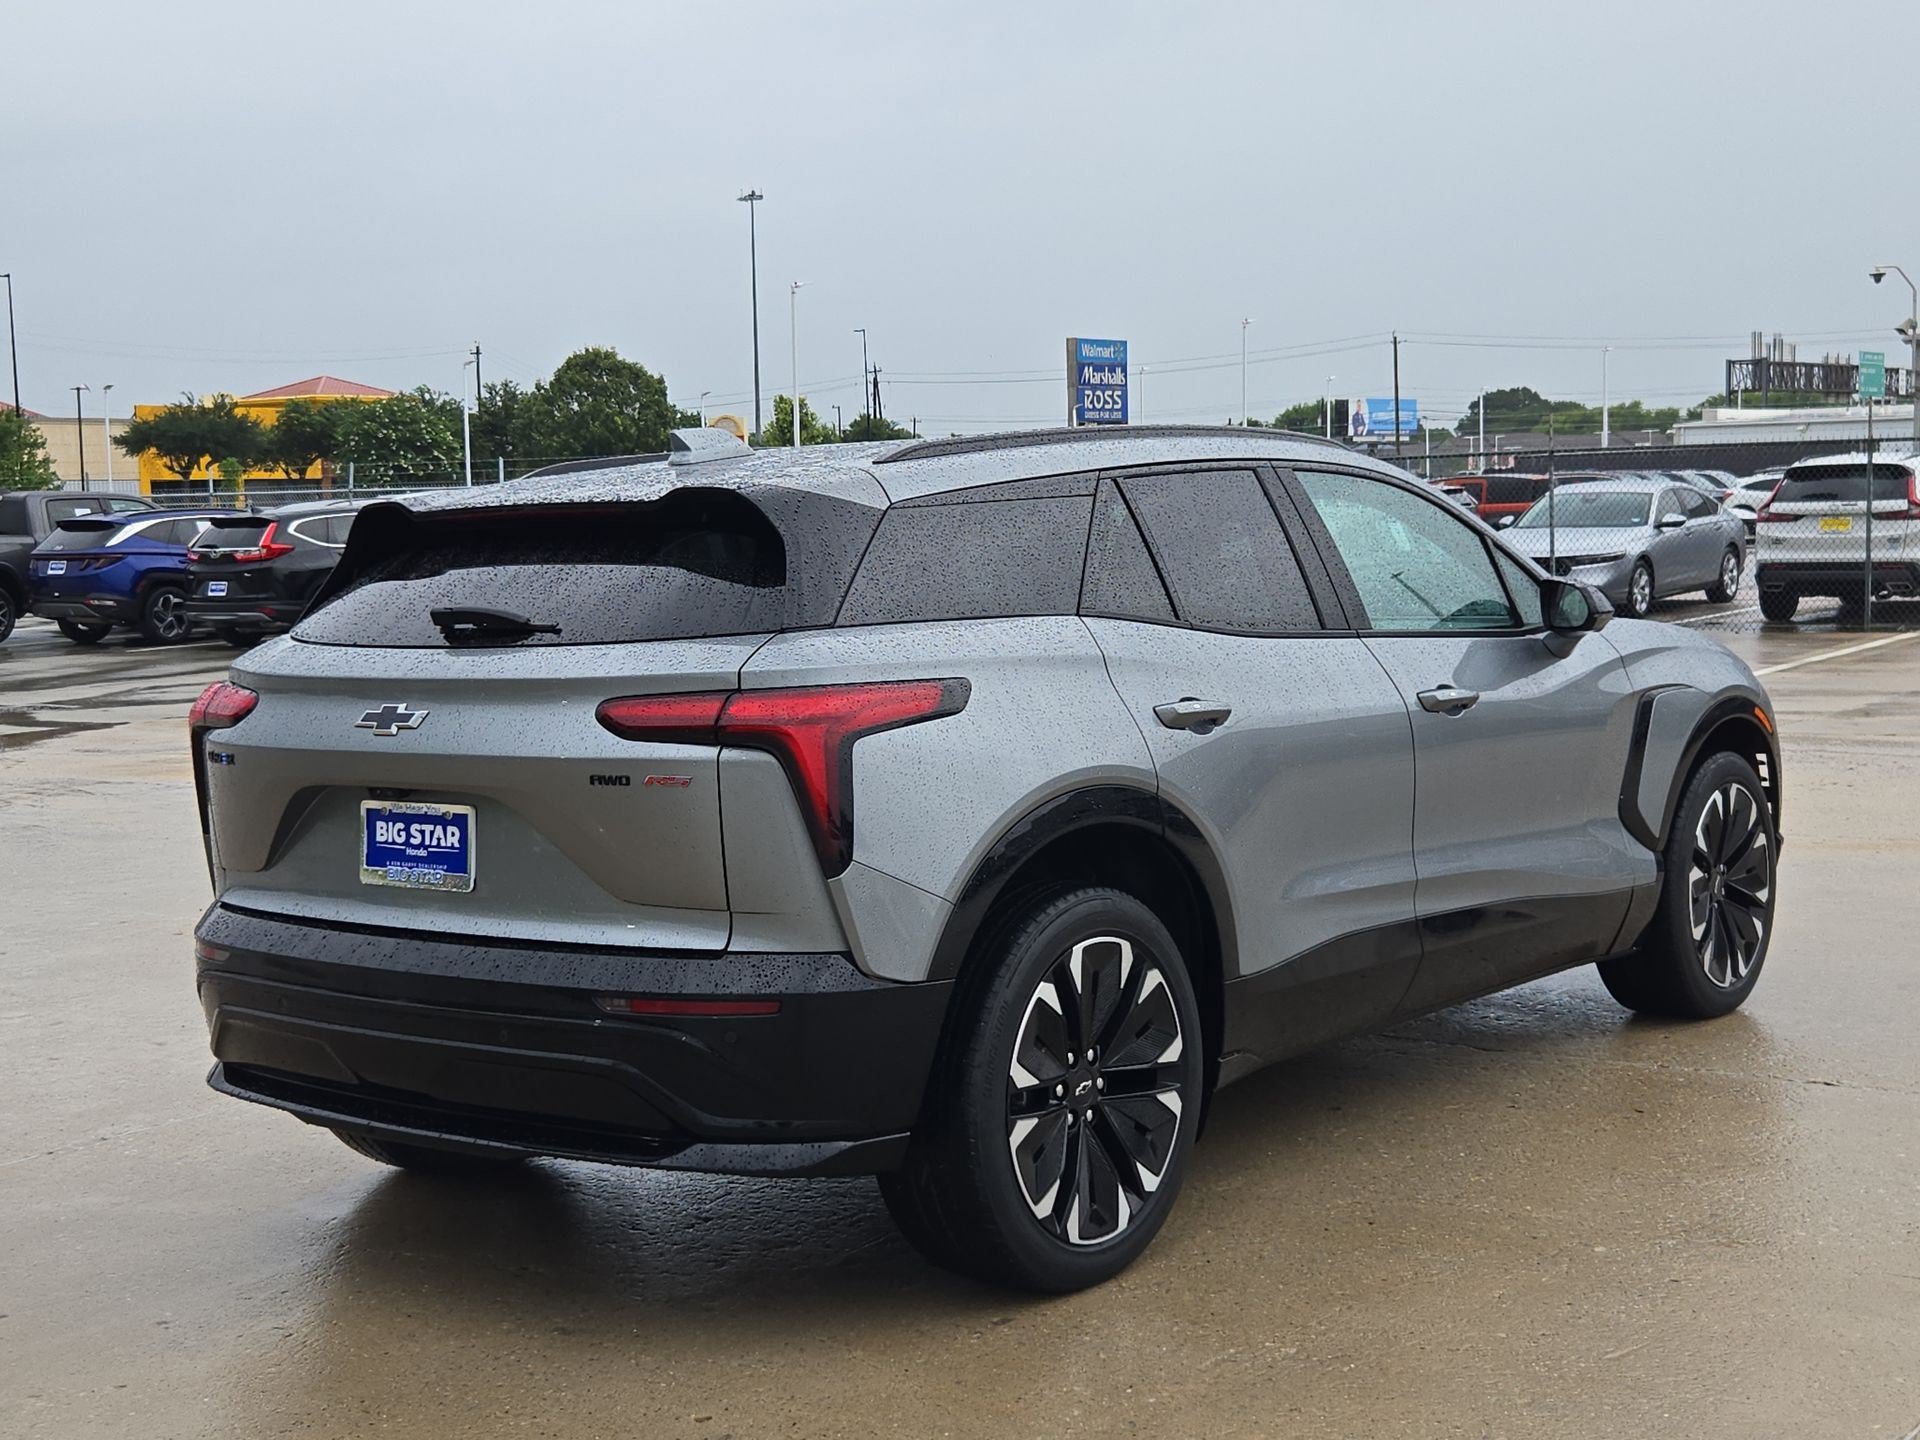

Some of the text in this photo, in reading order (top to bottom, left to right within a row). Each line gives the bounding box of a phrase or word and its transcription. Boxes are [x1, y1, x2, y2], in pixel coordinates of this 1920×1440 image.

[1081, 343, 1115, 358] Walmart
[1080, 365, 1126, 385] Marshalls
[1084, 390, 1122, 410] ROSS
[375, 820, 460, 848] BIG STAR
[406, 847, 428, 857] Honda
[387, 867, 444, 884] BIG STAR
